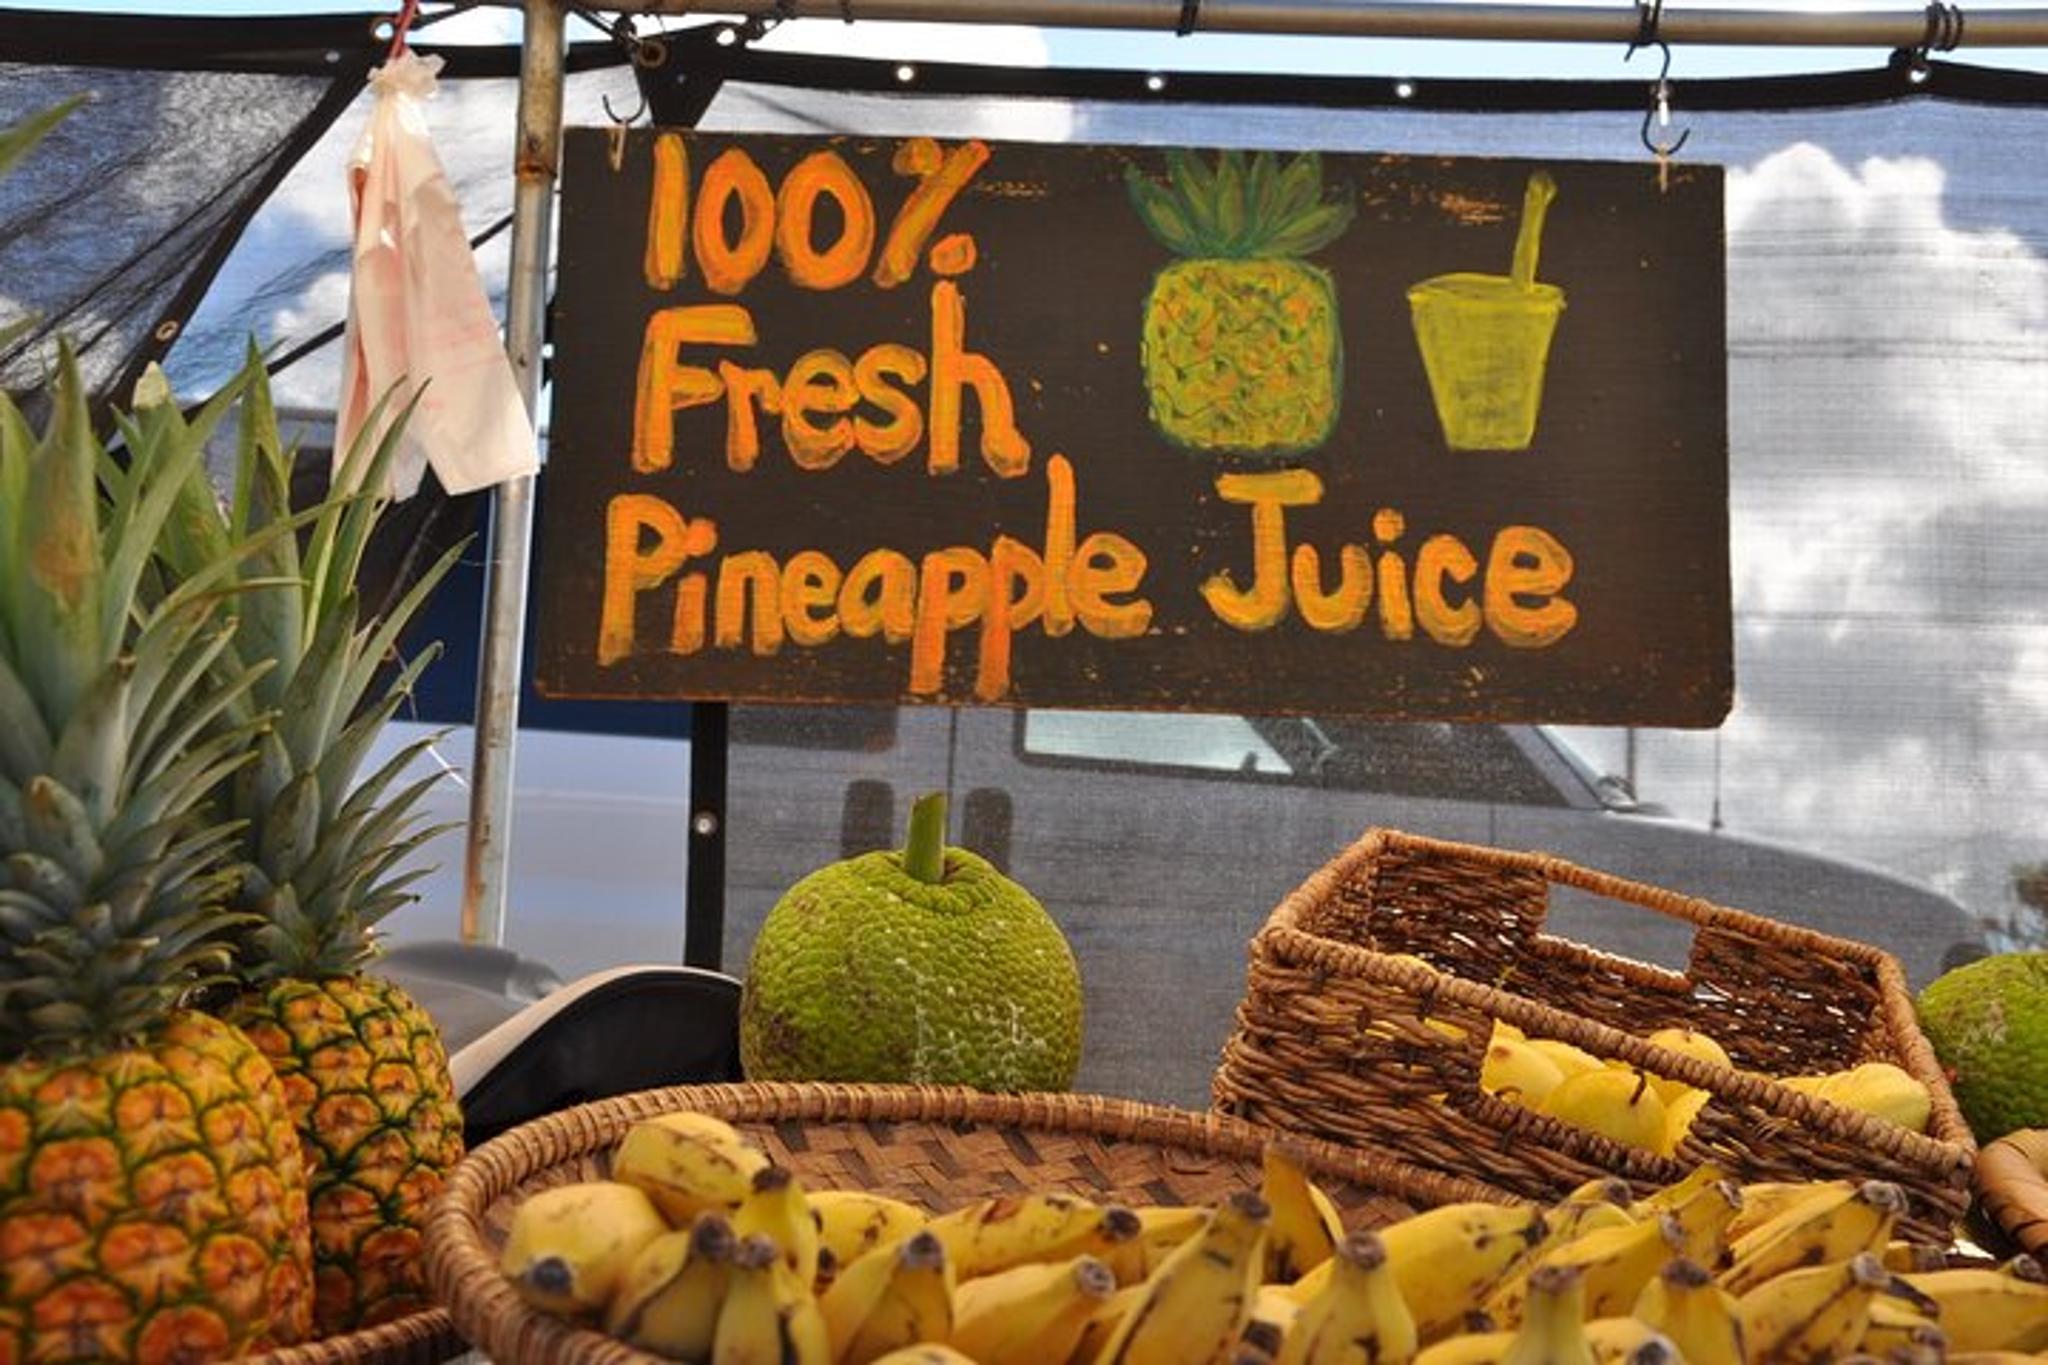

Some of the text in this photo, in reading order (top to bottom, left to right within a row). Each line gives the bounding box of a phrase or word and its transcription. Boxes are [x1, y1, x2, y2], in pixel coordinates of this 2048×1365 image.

[644, 134, 990, 294] 100%
[632, 279, 1031, 478] Fresh
[597, 454, 1578, 702] Pineapple Juice
